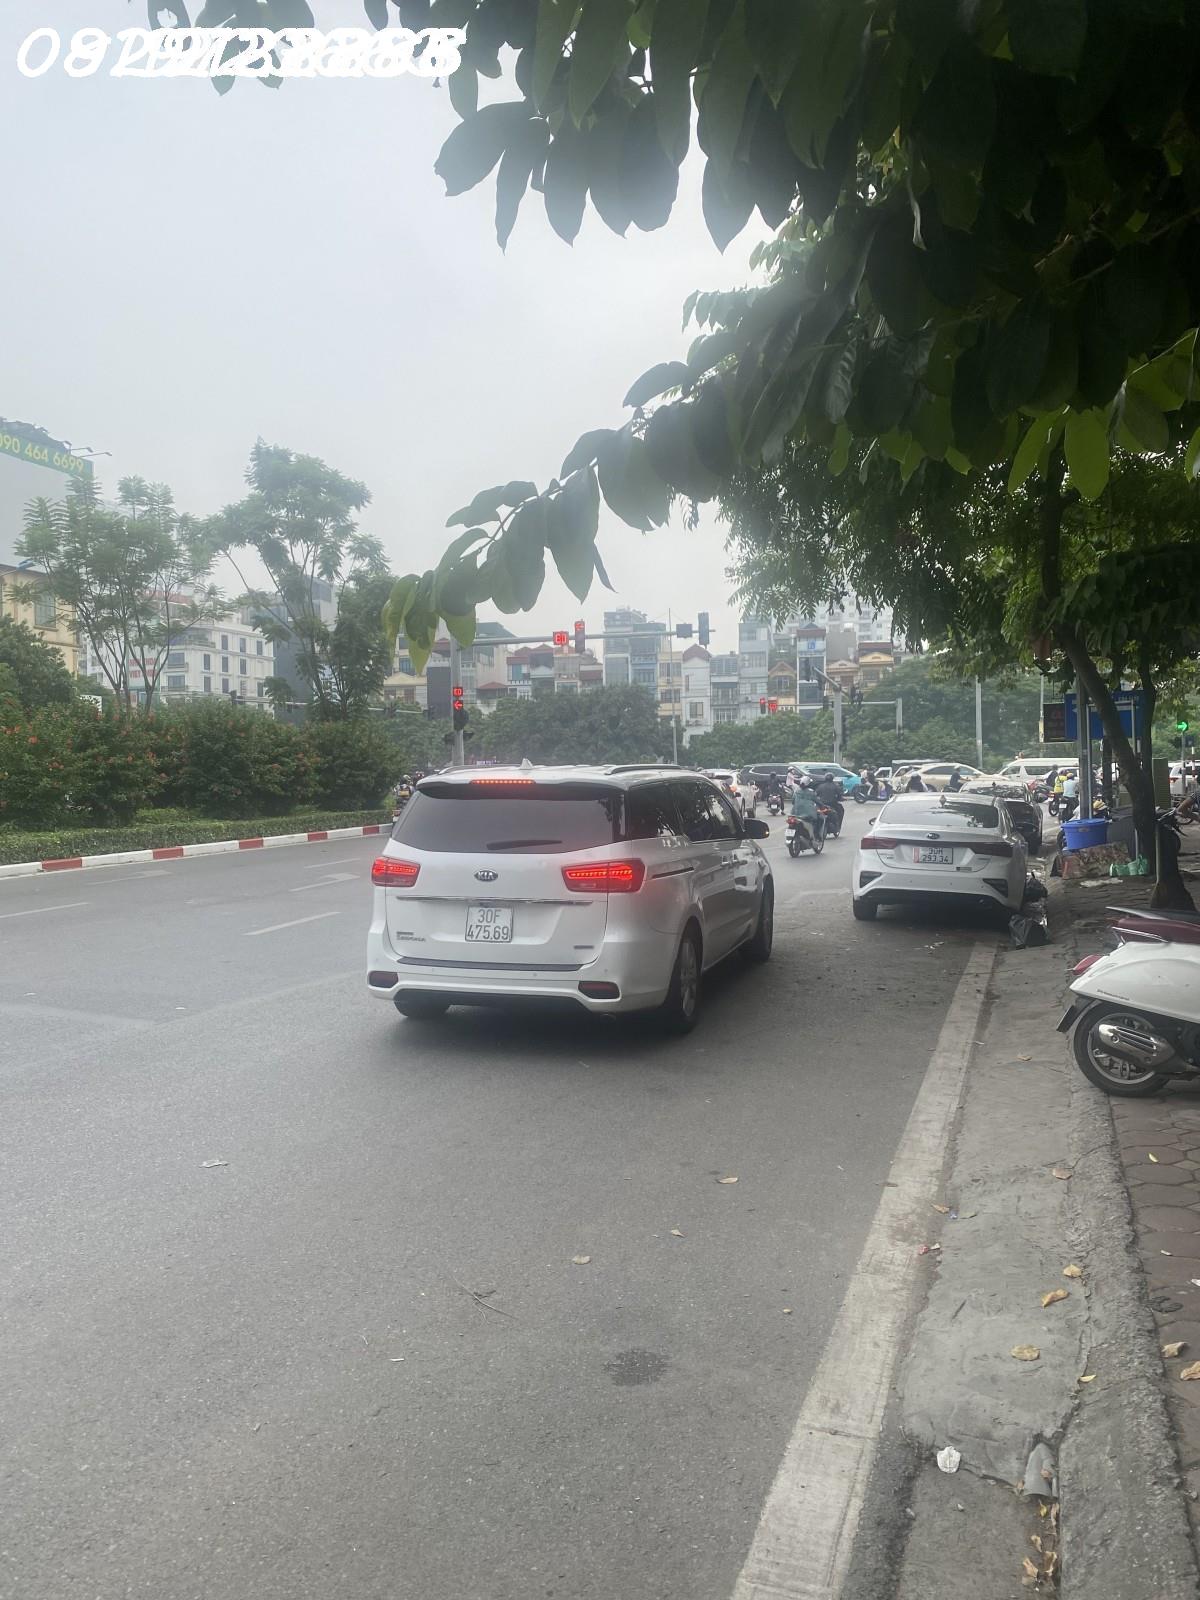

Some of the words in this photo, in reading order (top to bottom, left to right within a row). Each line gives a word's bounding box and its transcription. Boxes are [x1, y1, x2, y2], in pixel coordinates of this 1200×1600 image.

[25, 441, 48, 462] 464
[53, 452, 83, 472] 6699
[478, 871, 495, 880] KIA
[478, 908, 502, 923] 30F
[467, 924, 509, 940] 475.69
